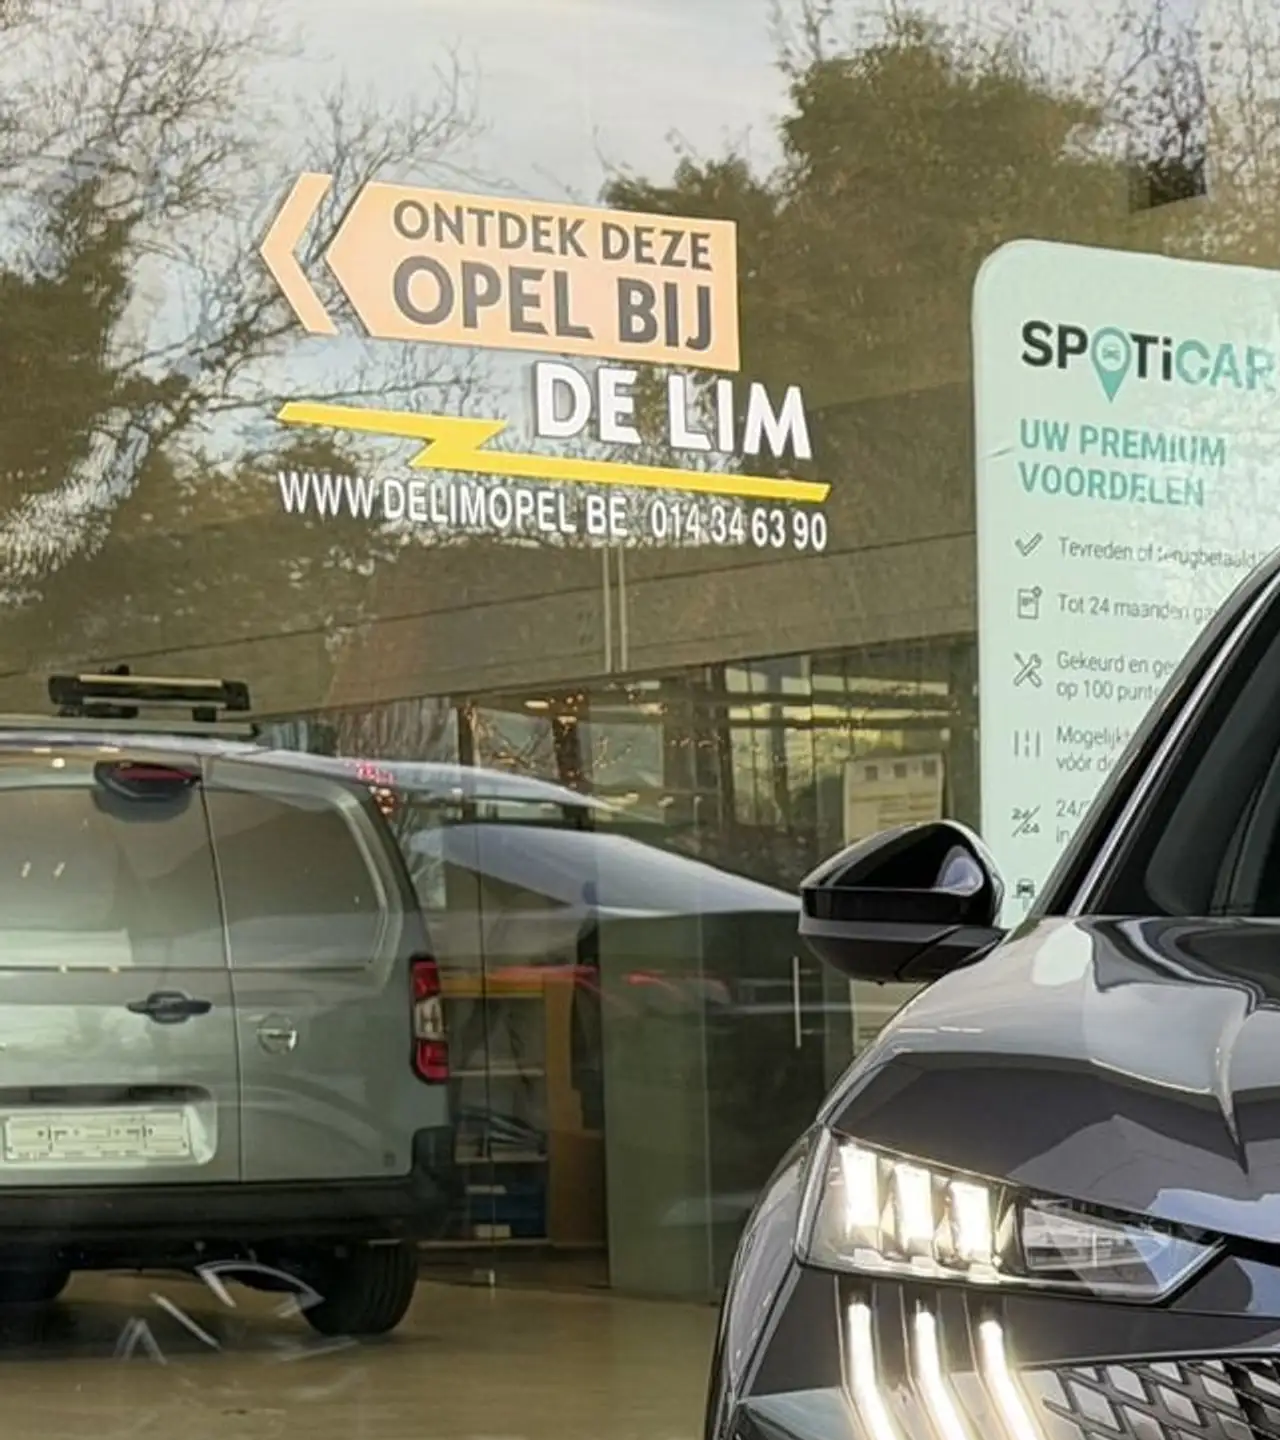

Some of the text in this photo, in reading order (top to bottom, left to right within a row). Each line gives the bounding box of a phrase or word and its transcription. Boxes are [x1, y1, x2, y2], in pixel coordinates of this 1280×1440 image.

[393, 200, 713, 271] ONTDEK DEZE
[393, 255, 712, 352] OPEL BIJ
[534, 361, 812, 460] DE LIM
[1020, 418, 1226, 467] UW PREMIUM
[1018, 461, 1205, 508] VOORDELEN
[752, 508, 785, 548] 63
[793, 512, 827, 551] 90
[1058, 537, 1133, 561] Tevreden
[1058, 593, 1084, 614] Tot
[1089, 597, 1110, 616] 24
[1057, 650, 1125, 673] Gekeurd
[1129, 658, 1149, 673] en
[1056, 681, 1078, 700] op
[1084, 680, 1114, 699] 100
